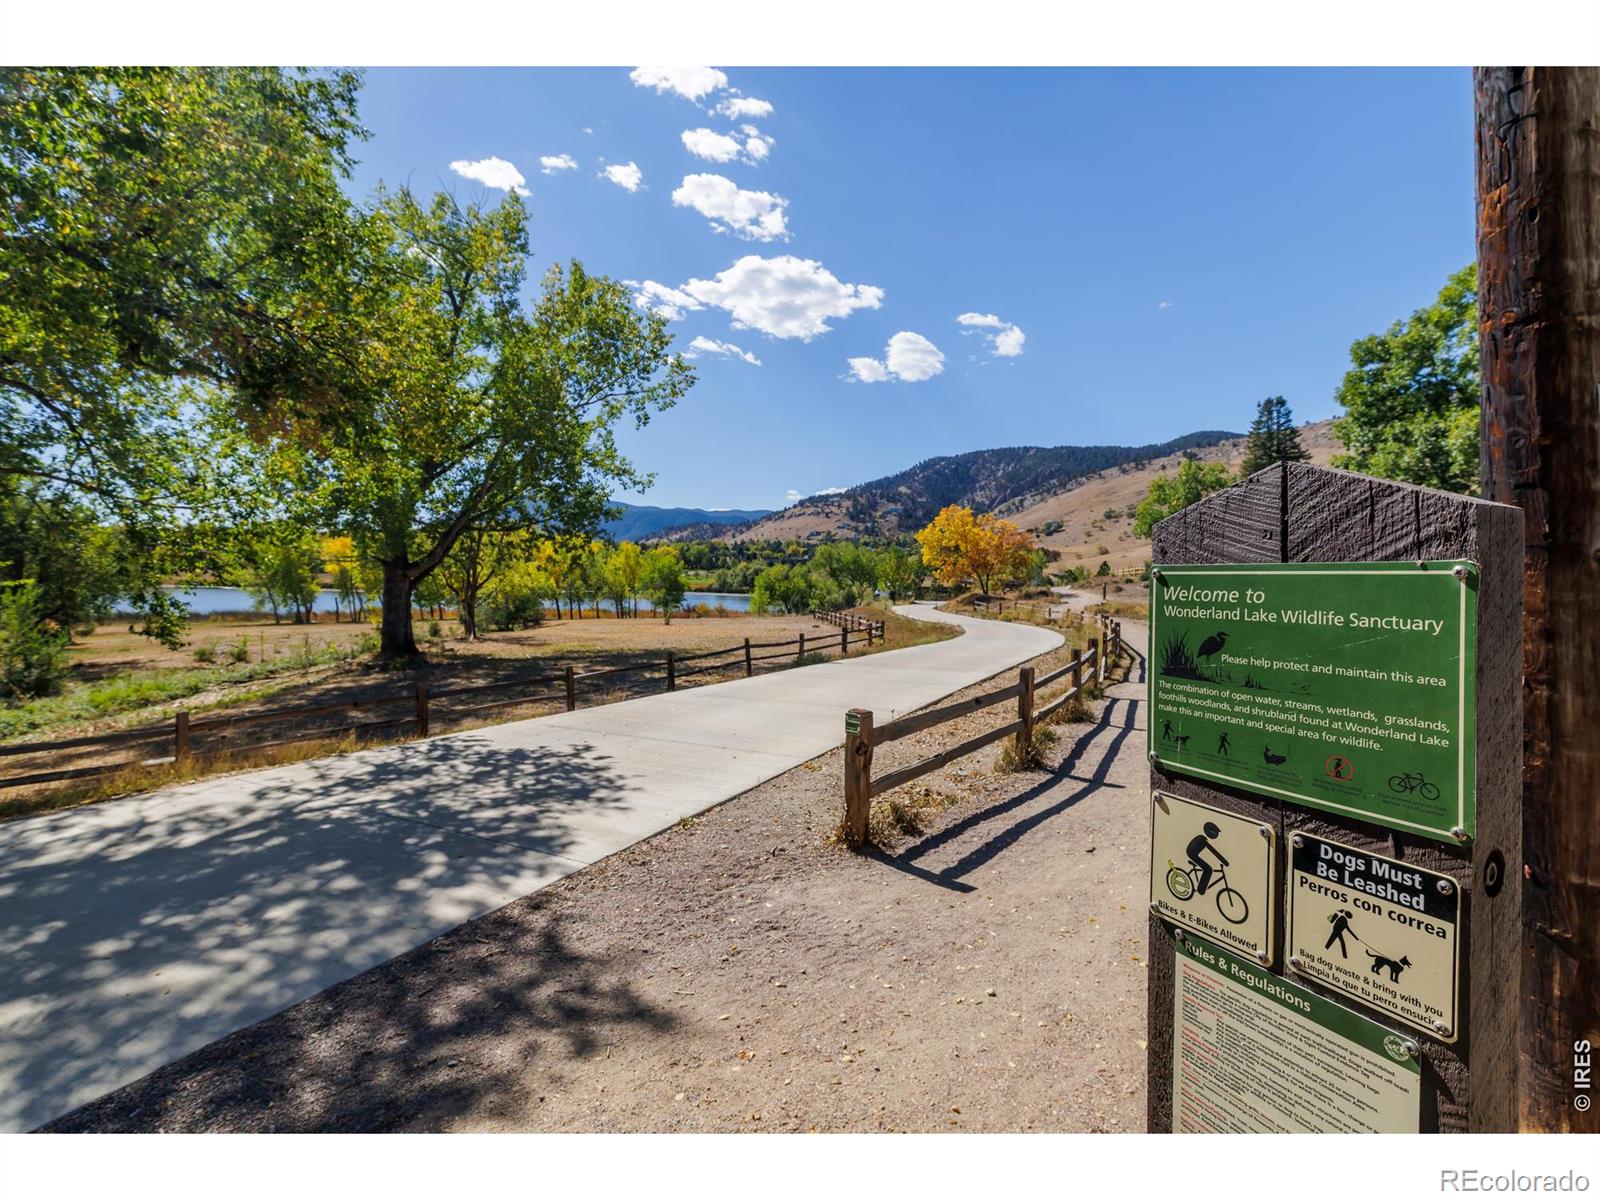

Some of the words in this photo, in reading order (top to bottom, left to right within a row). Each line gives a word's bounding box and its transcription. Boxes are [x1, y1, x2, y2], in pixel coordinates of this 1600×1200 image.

[1163, 585, 1239, 603] Welcome
[1245, 588, 1265, 604] to
[1163, 605, 1240, 620] Wonderland
[1244, 608, 1277, 623] Lake
[1281, 609, 1344, 626] Wildlife
[1349, 612, 1444, 635] Sanctuary
[1221, 654, 1248, 665] Please
[1250, 656, 1271, 668] help
[1273, 661, 1309, 672] protect
[1312, 664, 1333, 675] and
[1336, 666, 1388, 681] maintain
[1391, 671, 1414, 683] this
[1416, 676, 1447, 687] area
[1158, 691, 1187, 703] foothills
[1187, 696, 1232, 712] woodlands,
[1234, 705, 1250, 715] and
[1252, 707, 1297, 722] shrubland
[1299, 713, 1329, 728] found
[1331, 721, 1342, 730] at
[1345, 722, 1416, 742] Wonderland
[1420, 734, 1450, 748] Lake
[1158, 704, 1178, 713] make
[1179, 706, 1192, 716] this
[1193, 710, 1203, 718] an
[1204, 711, 1245, 726] important
[1246, 719, 1263, 729] and
[1265, 722, 1296, 735] special
[1297, 729, 1320, 740] area
[1322, 731, 1337, 742] for
[1340, 736, 1384, 752] wildlife.
[1159, 680, 1172, 689] The
[1173, 682, 1219, 697] combination
[1220, 689, 1231, 698] of
[1231, 693, 1253, 704] open
[1255, 695, 1282, 708] water,
[1284, 700, 1324, 714] streams,
[1326, 706, 1378, 722] wetlands,
[1384, 715, 1450, 733] grasslands,
[1317, 861, 1338, 881] Be
[1344, 871, 1425, 911] Leashed
[1320, 844, 1366, 872] Dogs
[1372, 859, 1423, 890] Must
[1158, 900, 1178, 916] Bikes
[1180, 910, 1186, 919] &
[1188, 913, 1218, 933] E-Bikes
[1220, 928, 1257, 951] Allowed
[1300, 876, 1348, 903] Perros
[1353, 897, 1382, 917] con
[1387, 909, 1447, 939] correa
[1185, 941, 1215, 965] Rules
[1219, 957, 1228, 972] &
[1231, 963, 1312, 1012] Regulations
[1300, 948, 1315, 962] Bag
[1317, 956, 1333, 970] dog
[1335, 965, 1361, 981] waste
[1363, 976, 1370, 986] &
[1372, 980, 1397, 999] bring
[1399, 992, 1421, 1009] with
[1424, 1004, 1443, 1018] you
[1303, 960, 1330, 978] Limpia
[1332, 973, 1341, 984] lo
[1342, 980, 1359, 992] que
[1361, 987, 1371, 997] tu
[1373, 993, 1398, 1010] perro
